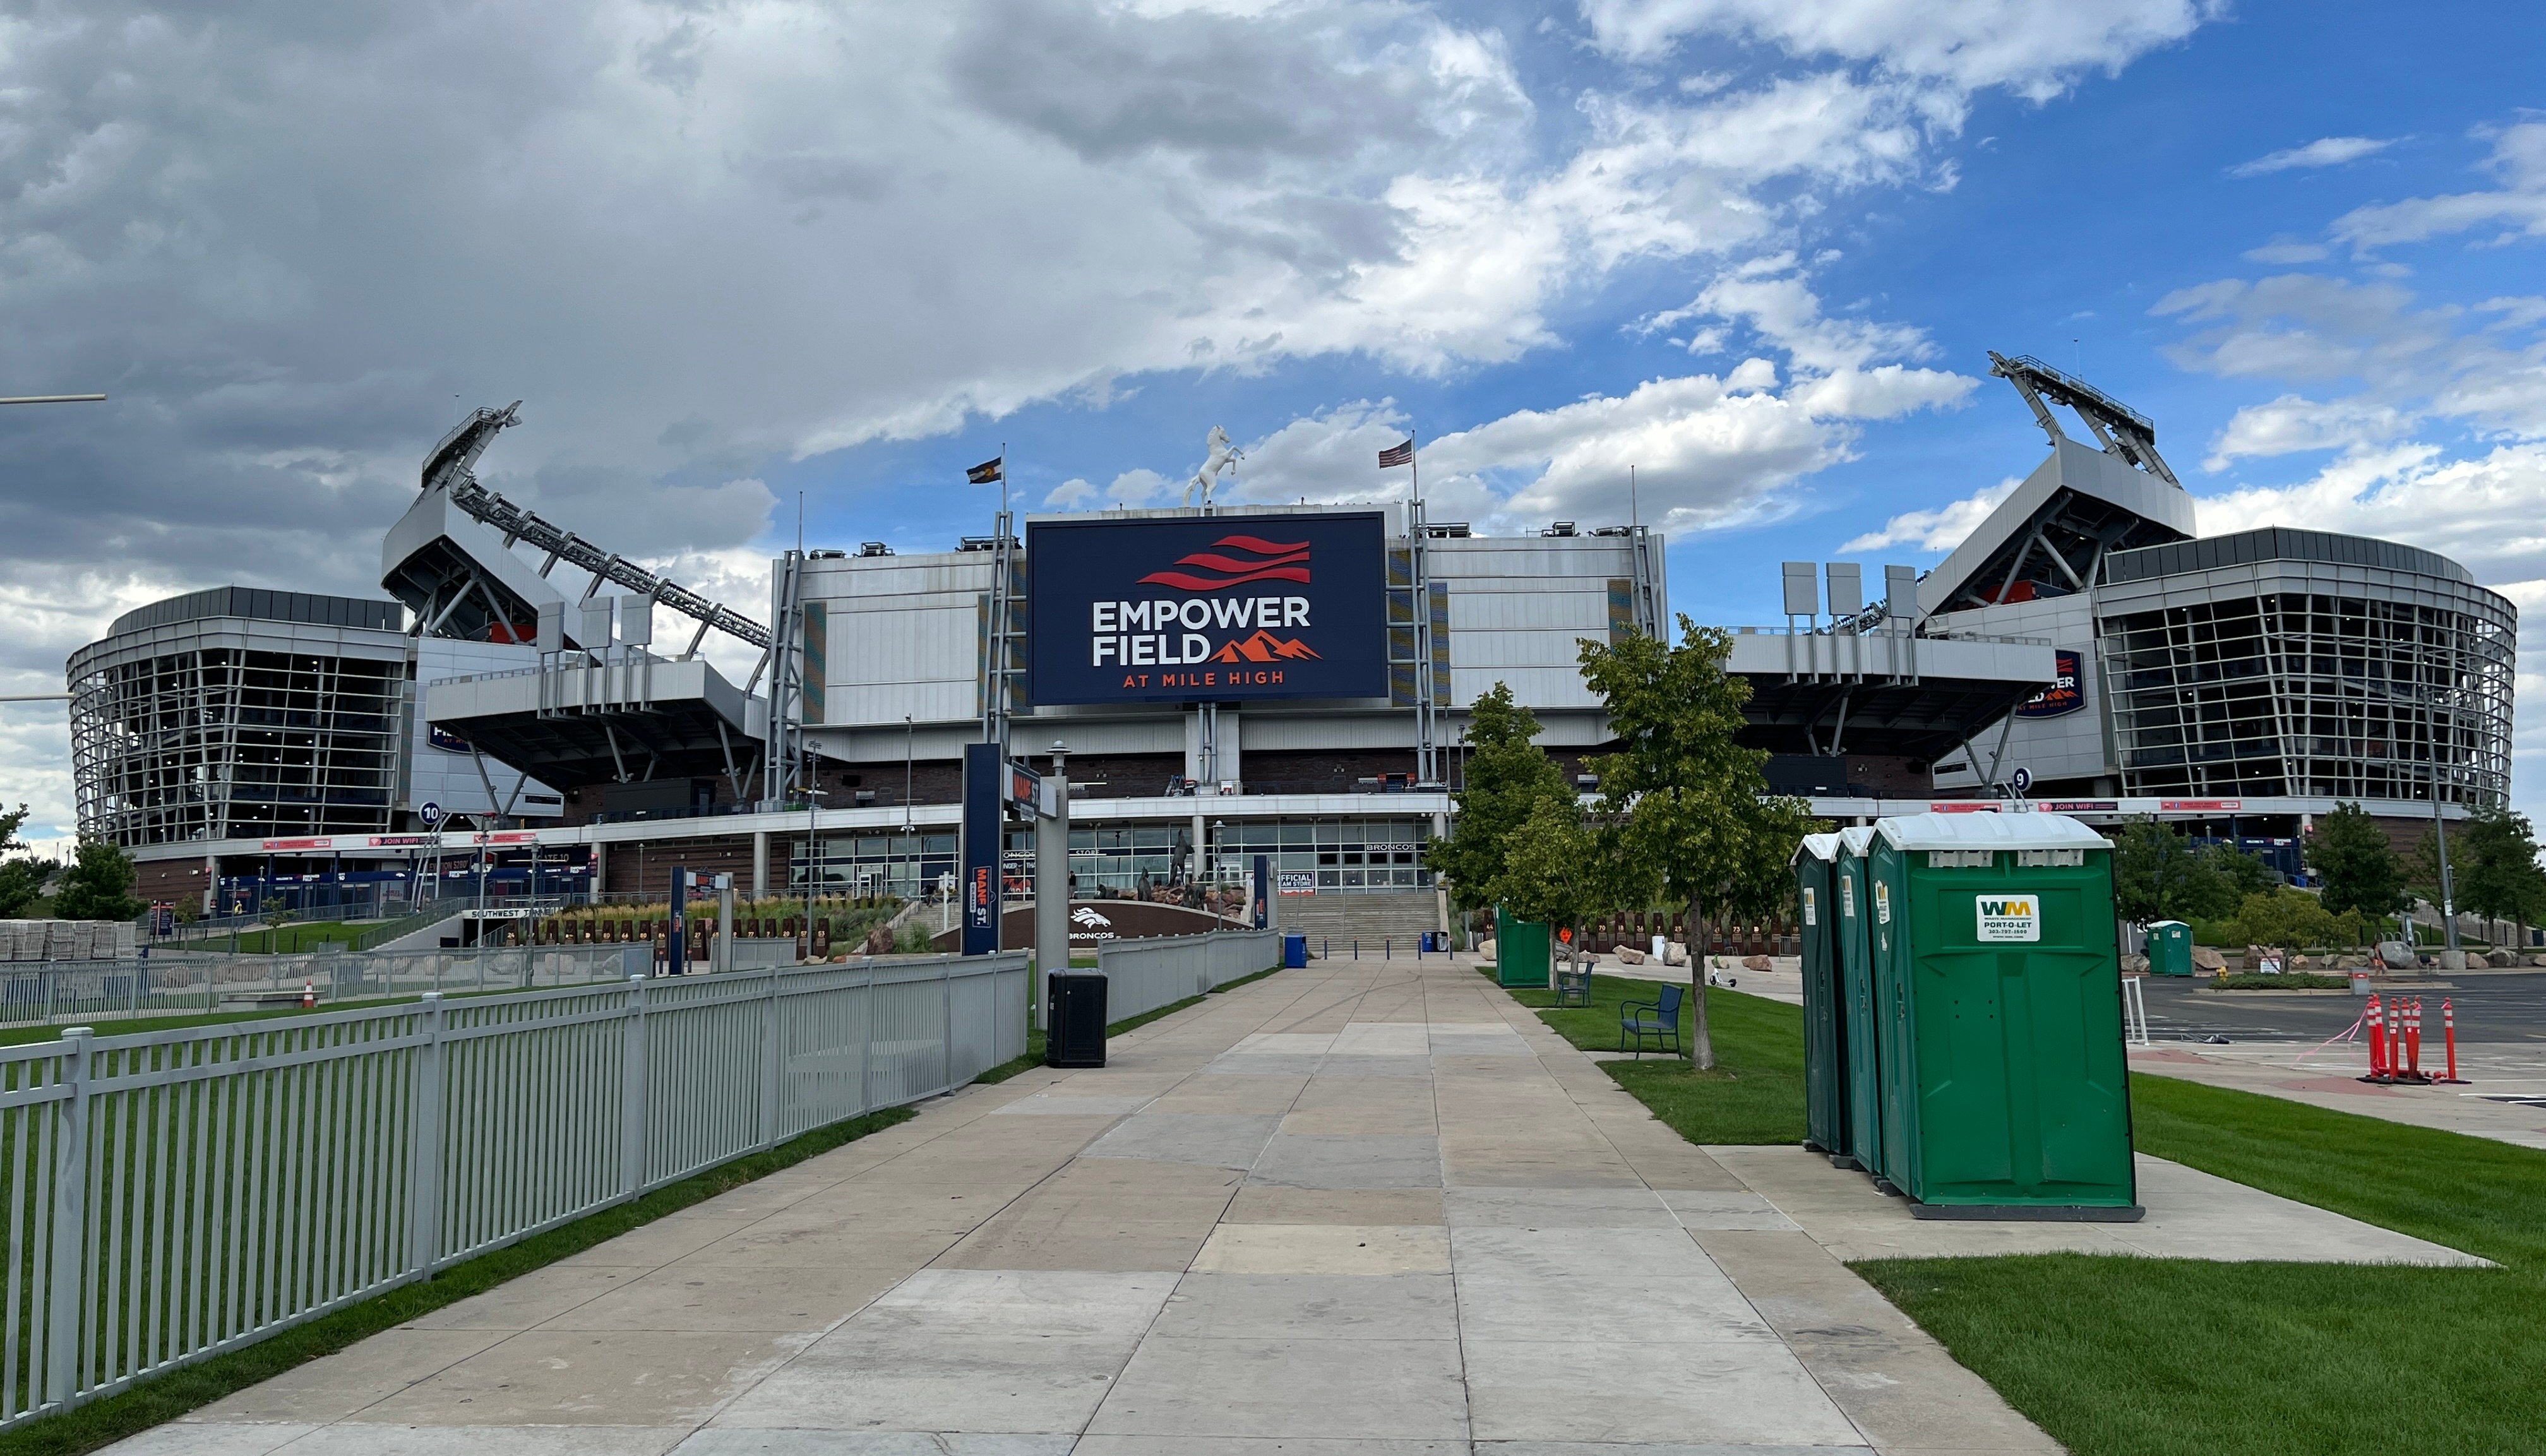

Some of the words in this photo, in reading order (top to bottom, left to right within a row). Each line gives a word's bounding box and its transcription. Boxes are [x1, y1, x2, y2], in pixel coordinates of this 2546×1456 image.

[1093, 596, 1311, 632] EMPOWER
[1093, 633, 1211, 667] FIELD
[1123, 675, 1149, 688] AT
[1162, 672, 1216, 687] MILE
[1229, 671, 1284, 684] HIGH
[2016, 773, 2024, 785] 9
[424, 807, 439, 820] 10
[977, 869, 987, 905] MANE
[977, 907, 986, 925] ST.
[1980, 901, 2032, 916] WM
